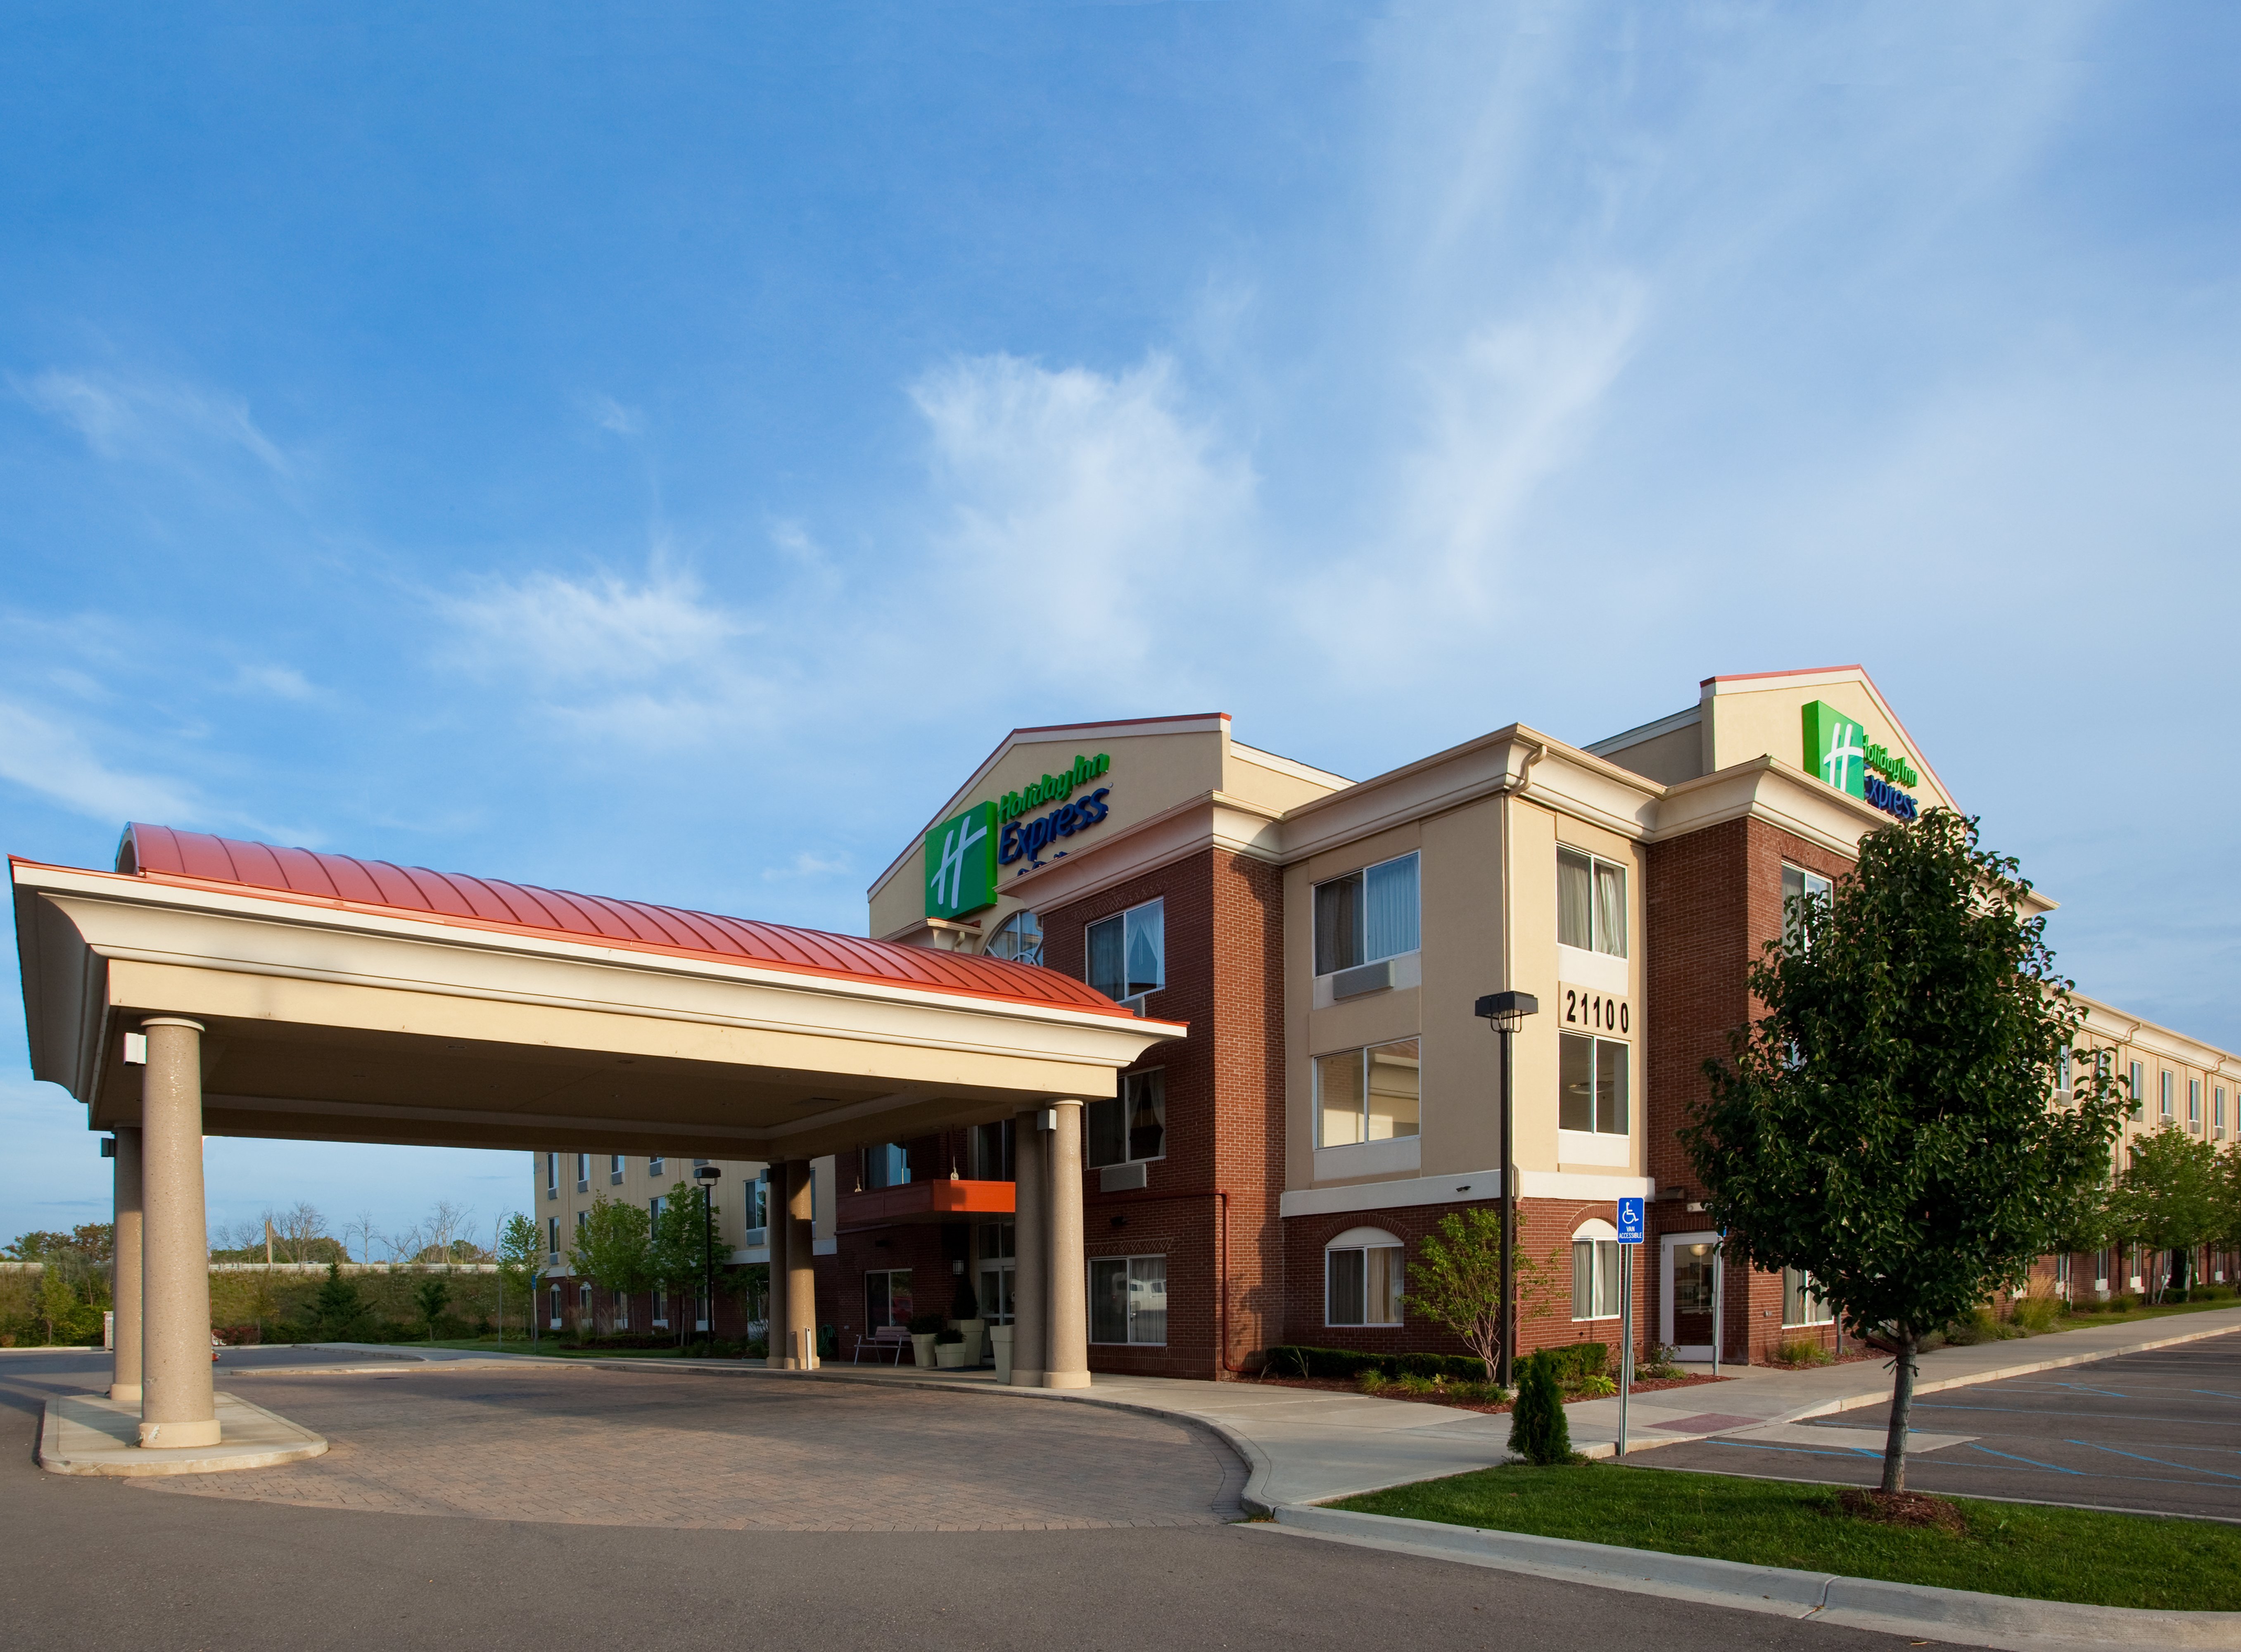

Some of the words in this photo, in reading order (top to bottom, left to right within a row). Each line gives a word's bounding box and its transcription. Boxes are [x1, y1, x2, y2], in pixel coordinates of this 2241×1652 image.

[998, 770, 1074, 824] Holiday
[1072, 753, 1110, 786] Inn
[1900, 757, 1917, 789] Inn
[998, 788, 1110, 865] Express
[1567, 990, 1629, 1034] 21100
